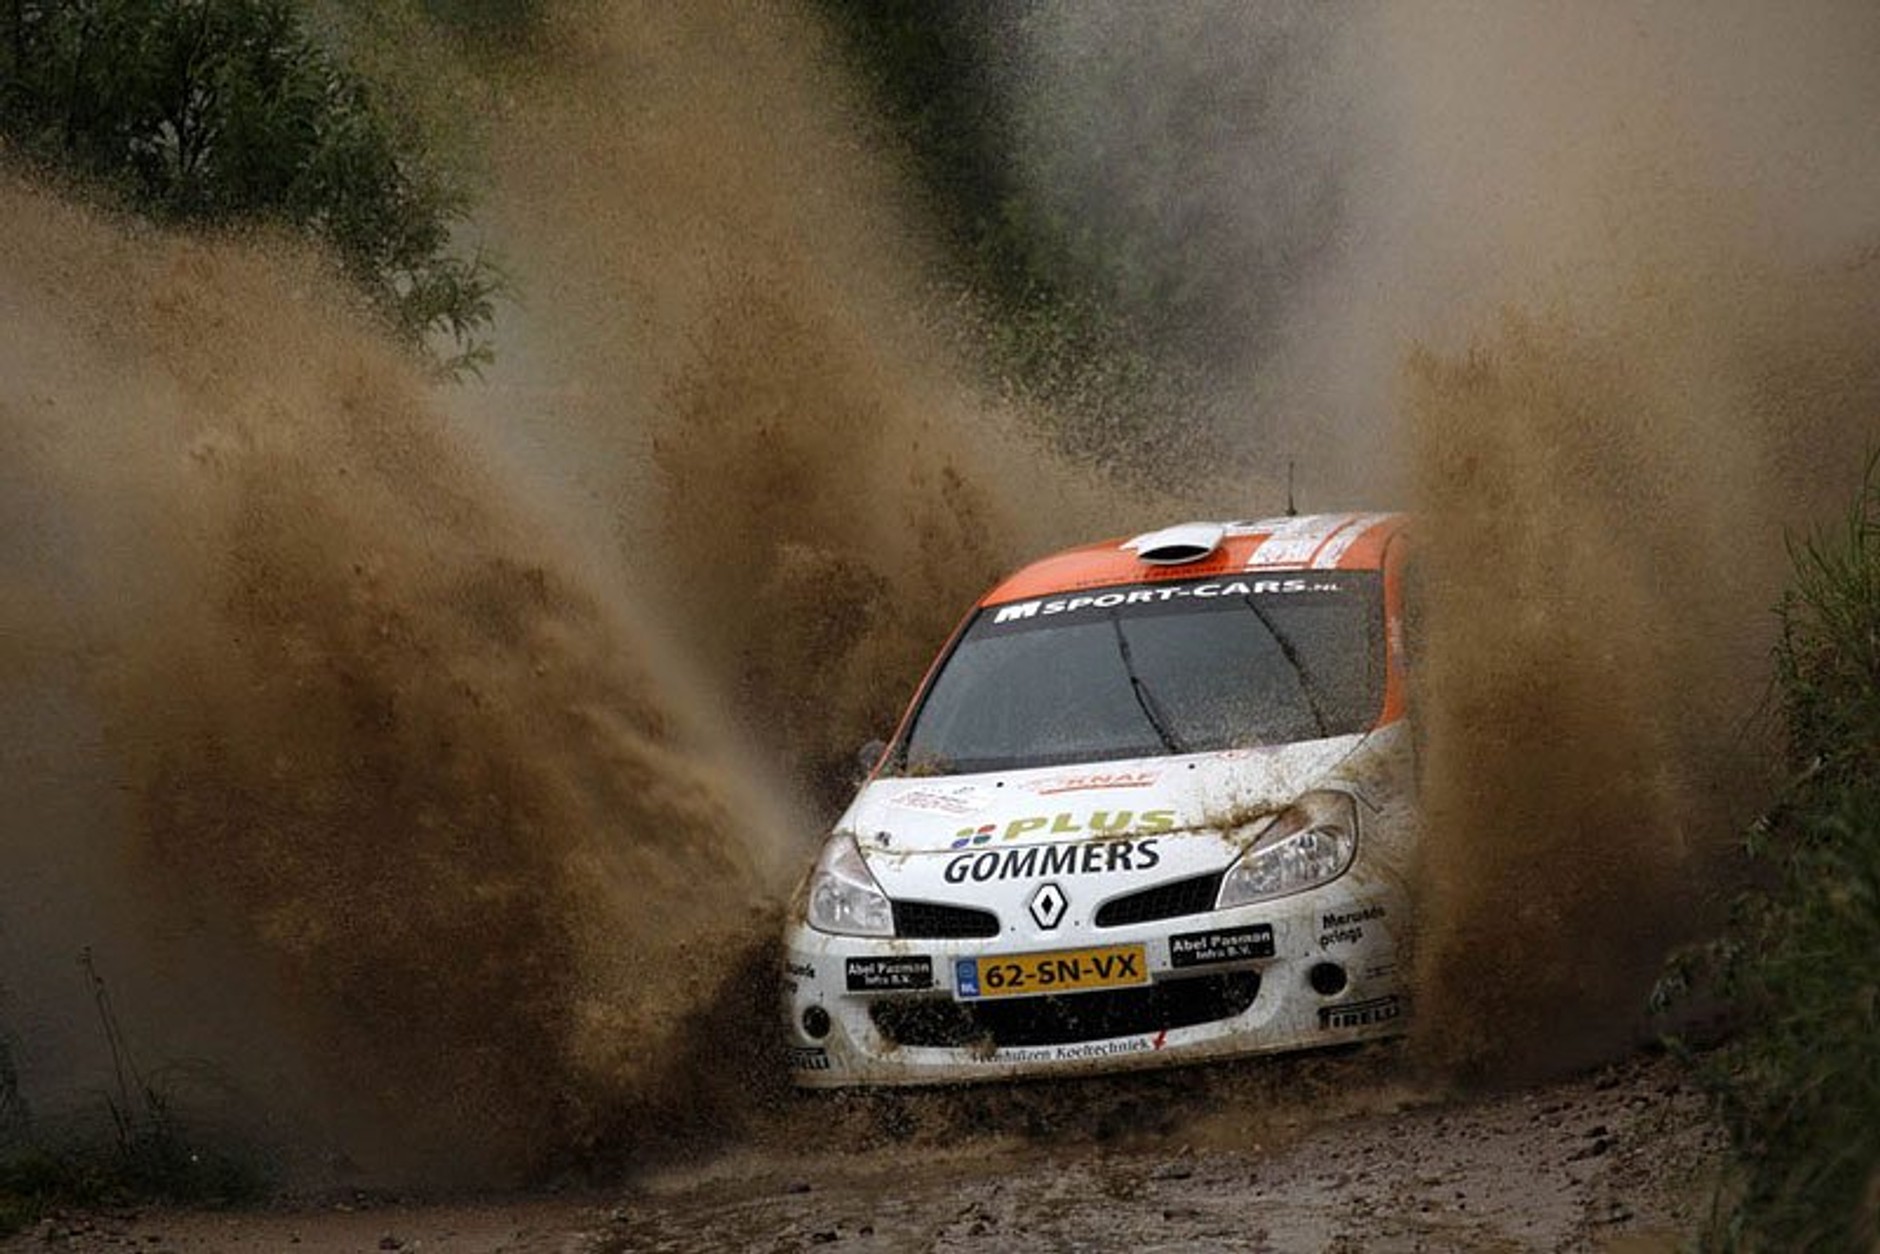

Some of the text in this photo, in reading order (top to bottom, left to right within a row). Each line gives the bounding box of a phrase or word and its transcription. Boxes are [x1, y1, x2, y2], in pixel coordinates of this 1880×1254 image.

[1003, 810, 1176, 841] PLUS
[943, 838, 1161, 884] GOMMERS
[1173, 937, 1207, 953] Abel
[848, 961, 875, 975] Abel
[985, 953, 1139, 989] 62-SN-VX
